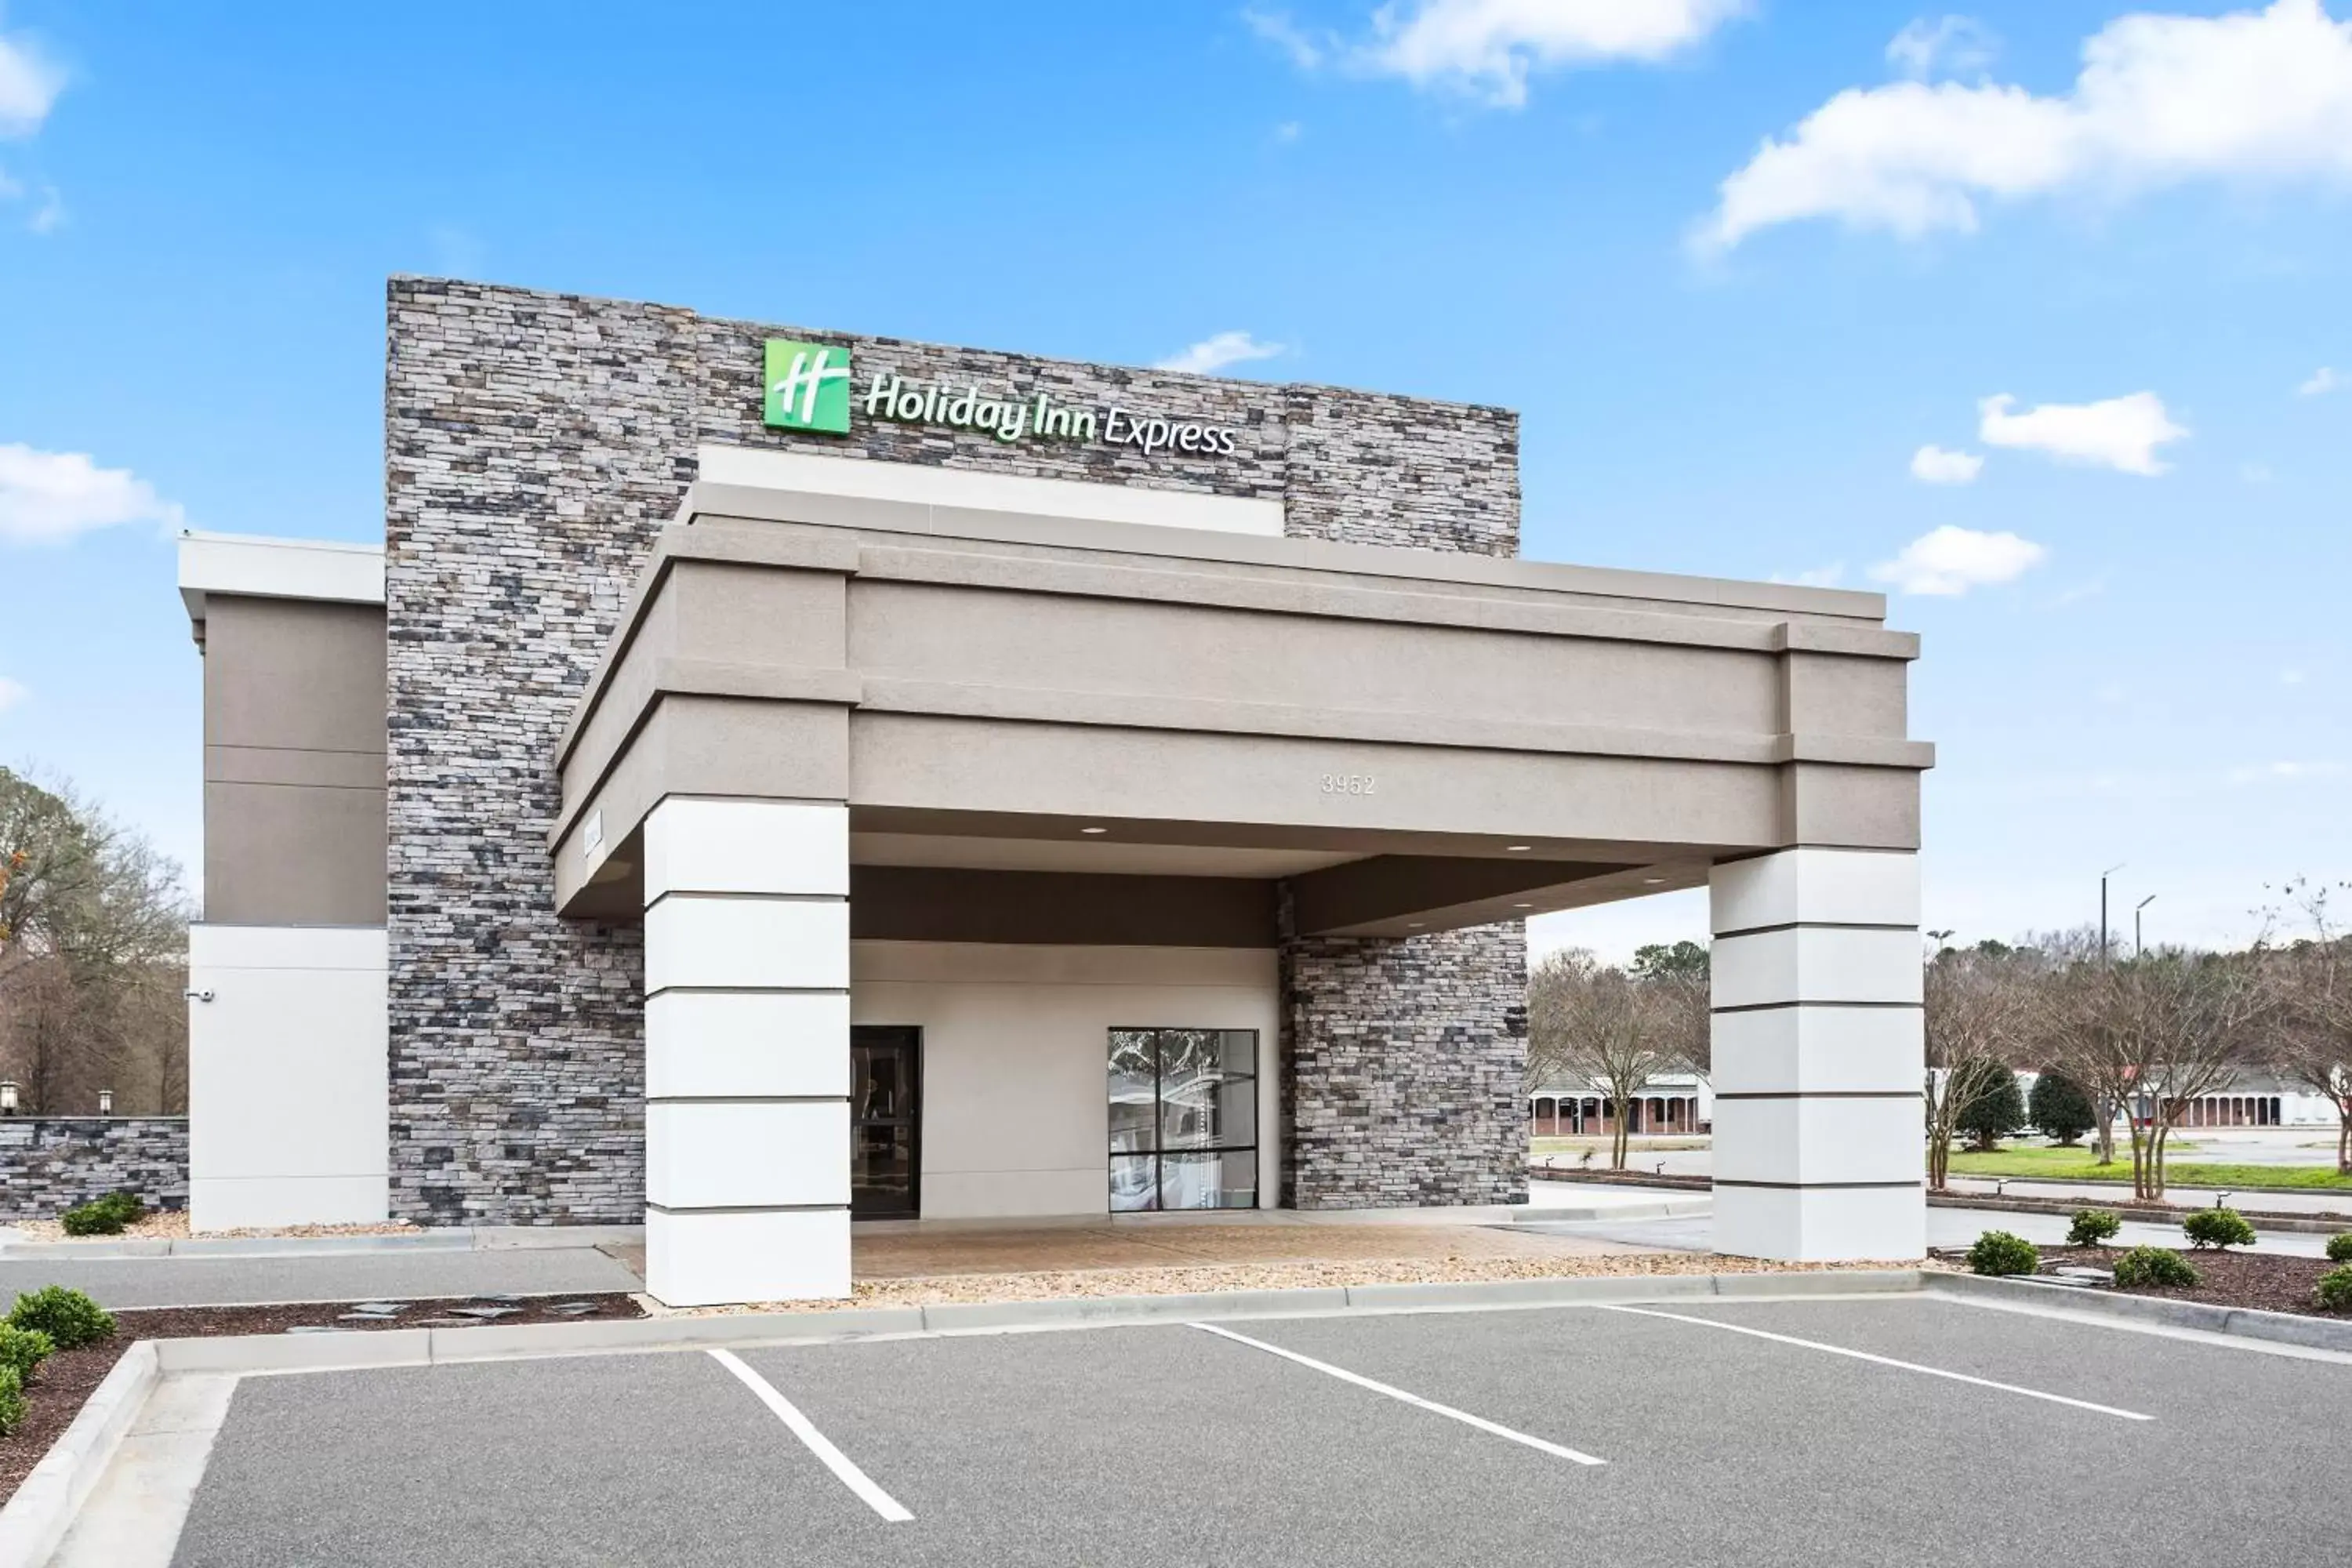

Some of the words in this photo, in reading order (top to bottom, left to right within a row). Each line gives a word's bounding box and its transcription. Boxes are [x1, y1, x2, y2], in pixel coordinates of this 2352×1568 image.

[772, 350, 849, 423] H
[864, 373, 1026, 441] Holiday
[1034, 394, 1095, 439] Inn
[1104, 407, 1235, 455] Express
[1322, 774, 1374, 794] 3952
